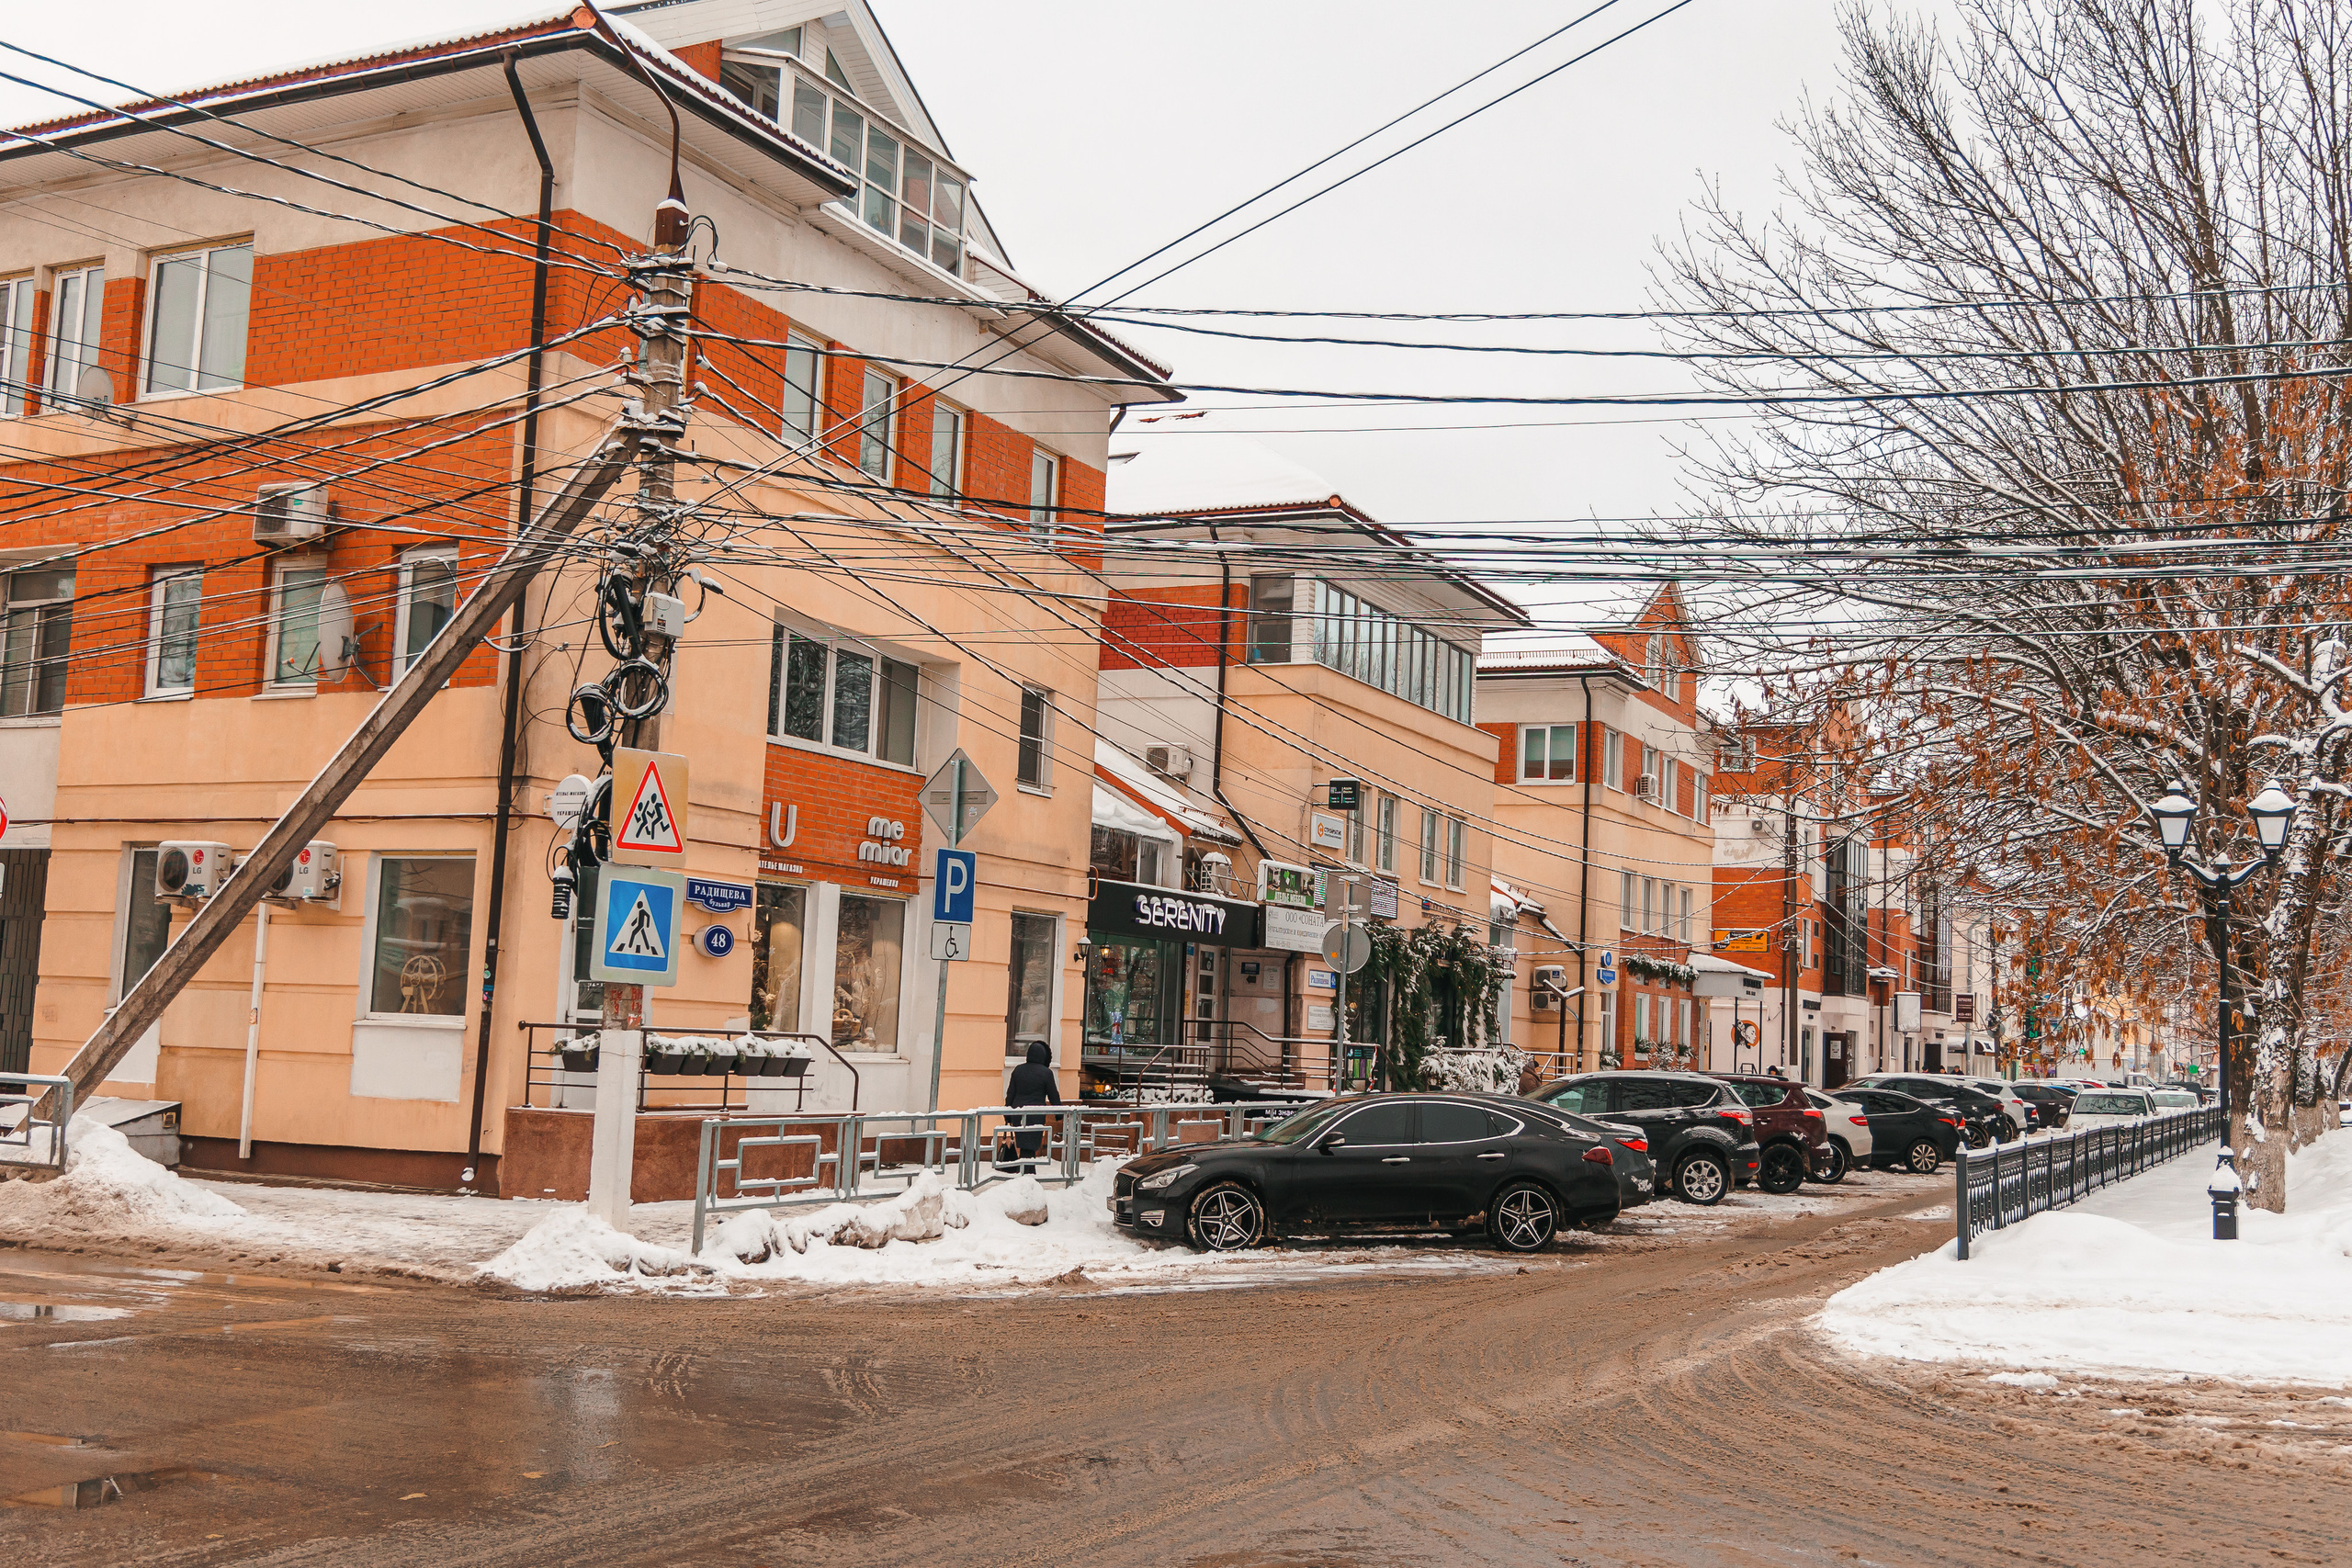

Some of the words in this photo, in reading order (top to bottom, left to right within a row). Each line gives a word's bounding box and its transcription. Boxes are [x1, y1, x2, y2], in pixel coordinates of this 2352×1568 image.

[867, 817, 905, 840] me
[192, 866, 202, 874] LG
[299, 866, 309, 874] LG
[778, 863, 803, 874] МАГАЗИН
[869, 875, 899, 888] УКРАШЕНИЯ
[944, 857, 967, 913] P
[695, 885, 746, 900] РАДИЩЕВА
[708, 898, 731, 908] бульвар
[1135, 895, 1227, 935] SERENITY
[710, 932, 727, 949] 48
